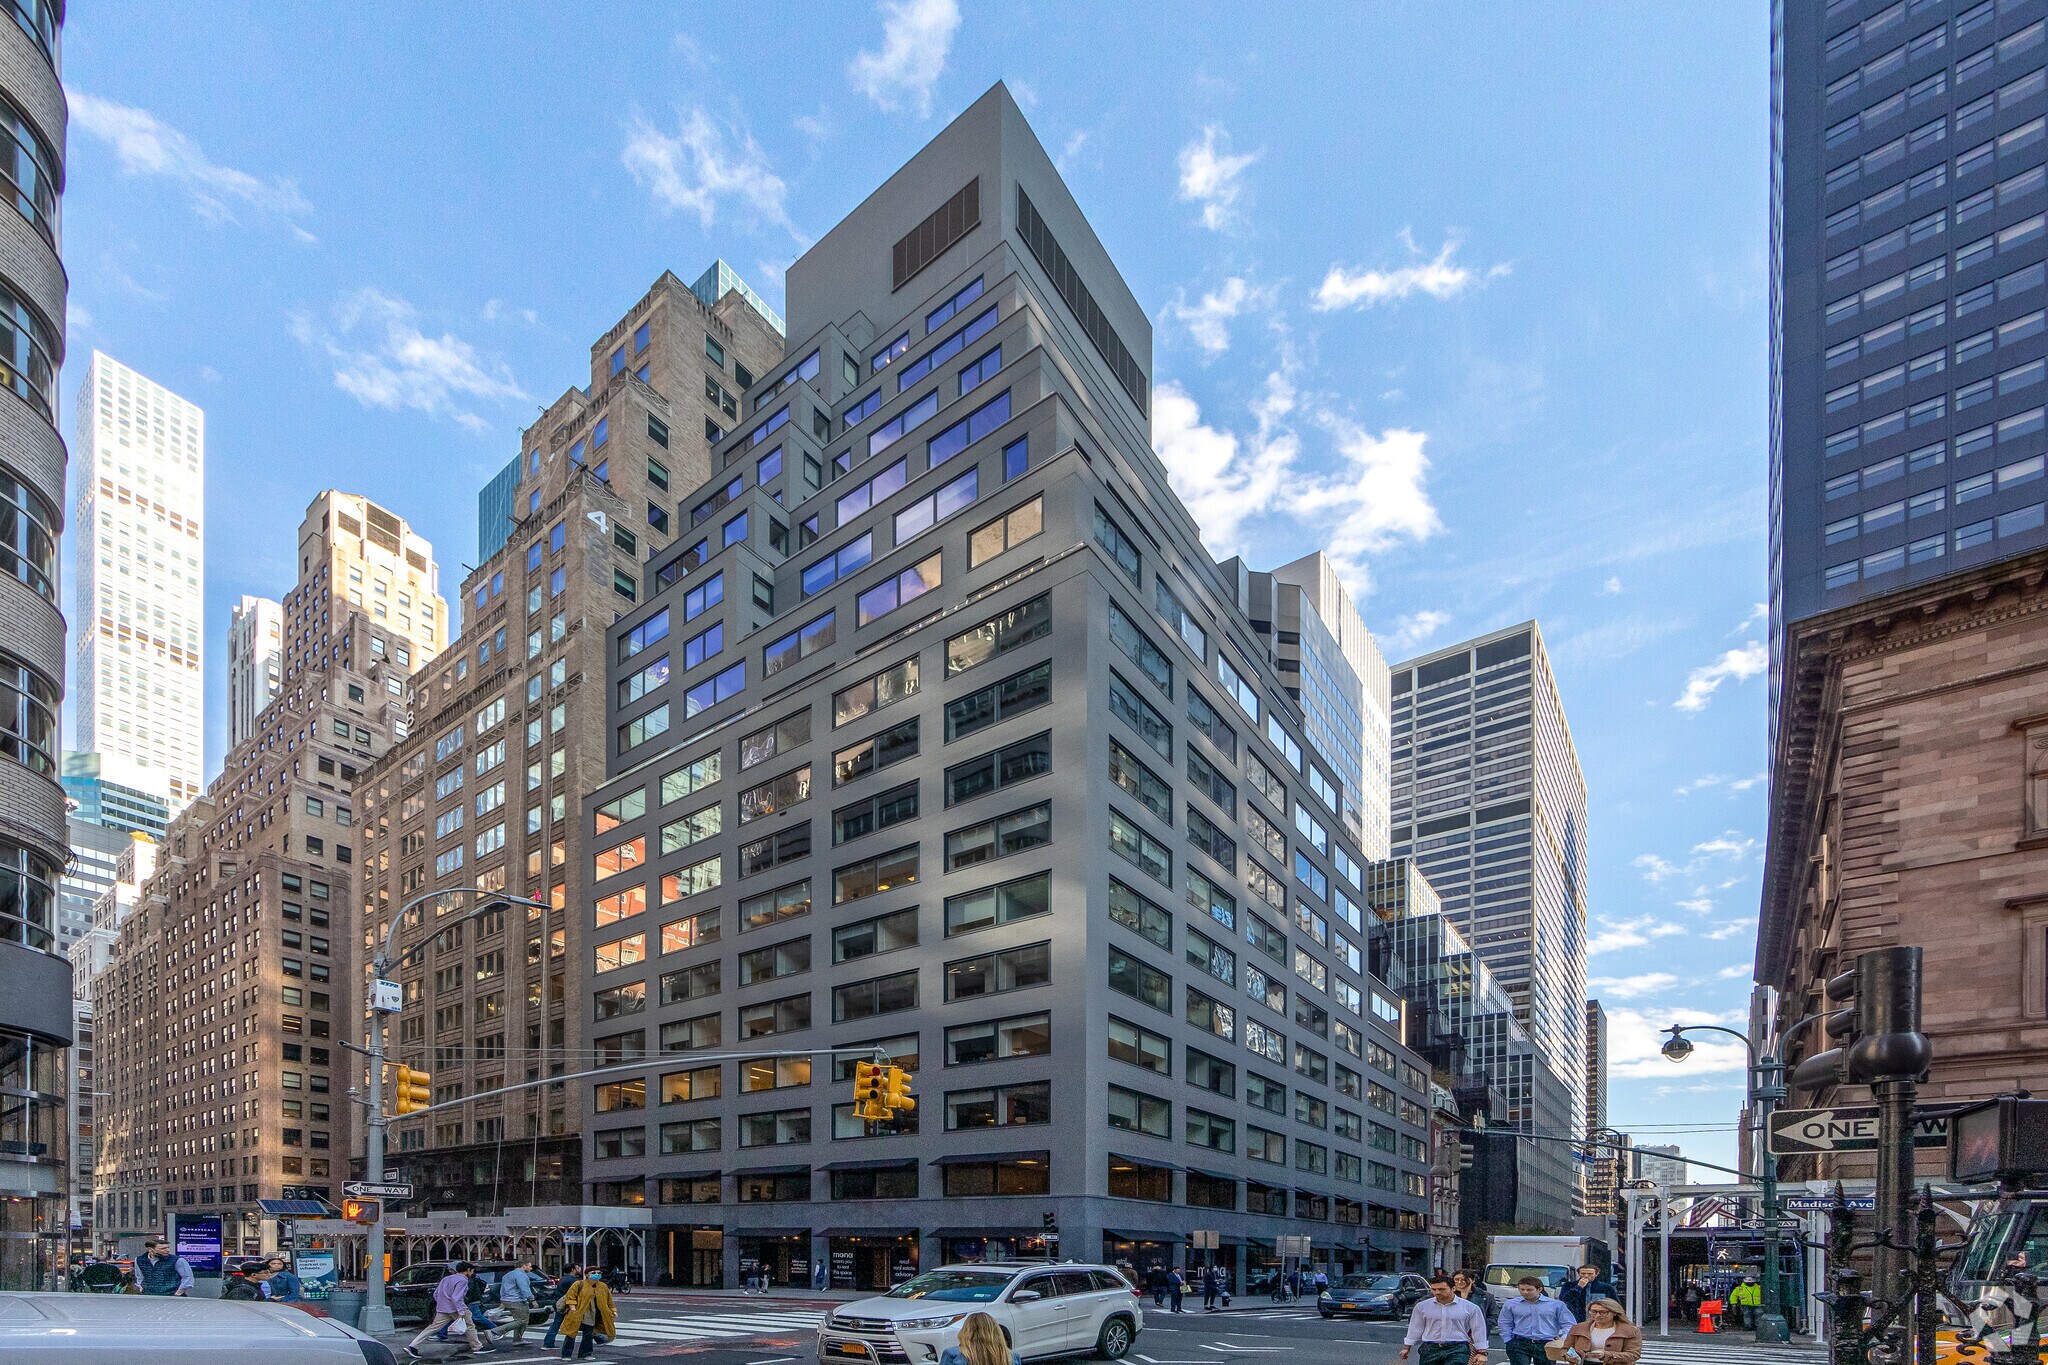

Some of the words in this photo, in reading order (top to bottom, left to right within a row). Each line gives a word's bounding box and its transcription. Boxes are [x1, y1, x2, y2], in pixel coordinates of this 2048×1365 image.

[1802, 1120, 1875, 1139] ONE
[352, 1185, 373, 1193] ONE
[1789, 1200, 1835, 1208] Madiso
[1848, 1200, 1873, 1208] Ave
